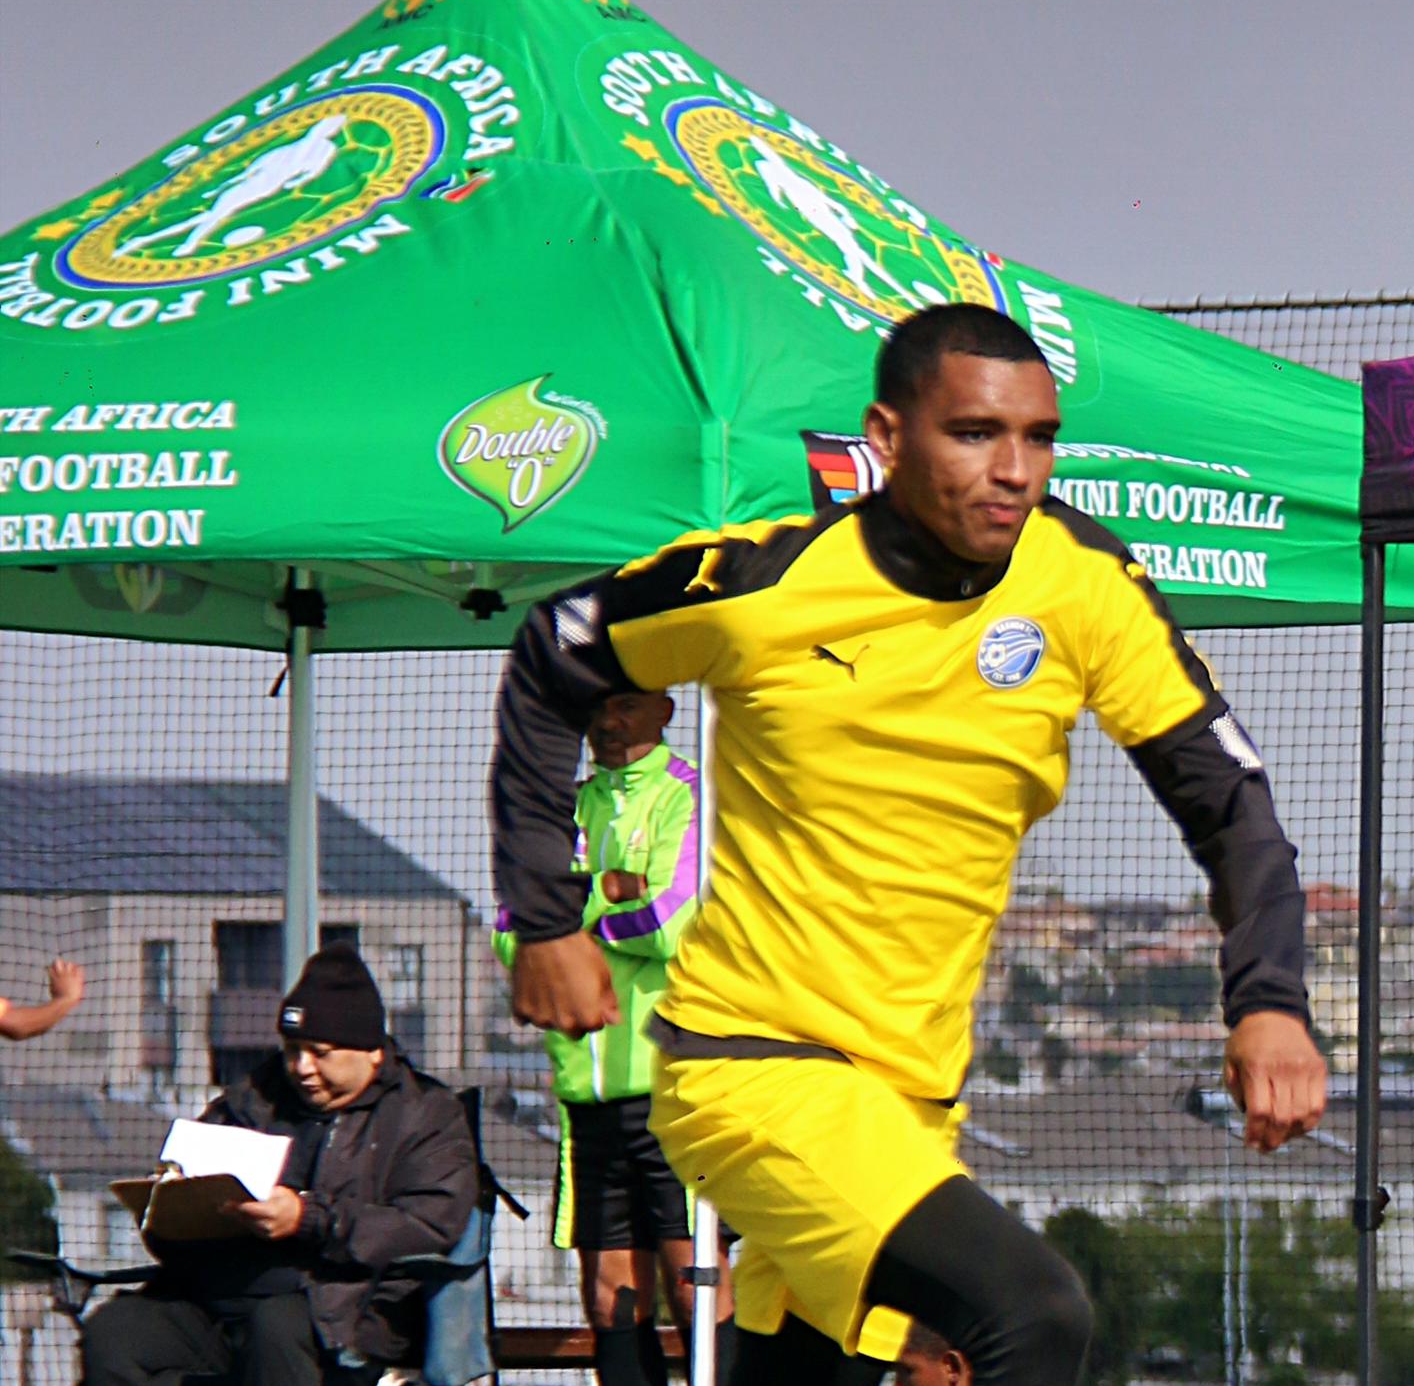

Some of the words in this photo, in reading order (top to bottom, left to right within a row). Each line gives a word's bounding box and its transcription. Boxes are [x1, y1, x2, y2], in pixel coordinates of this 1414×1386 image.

[161, 44, 401, 169] SOUTH
[395, 44, 520, 161] AFRICA
[600, 50, 707, 126] SOUTH
[226, 213, 412, 306] MINI
[51, 400, 235, 432] AFRICA
[455, 415, 576, 464] Double
[1048, 477, 1120, 518] MINI
[1126, 481, 1285, 530] FOOTBALL
